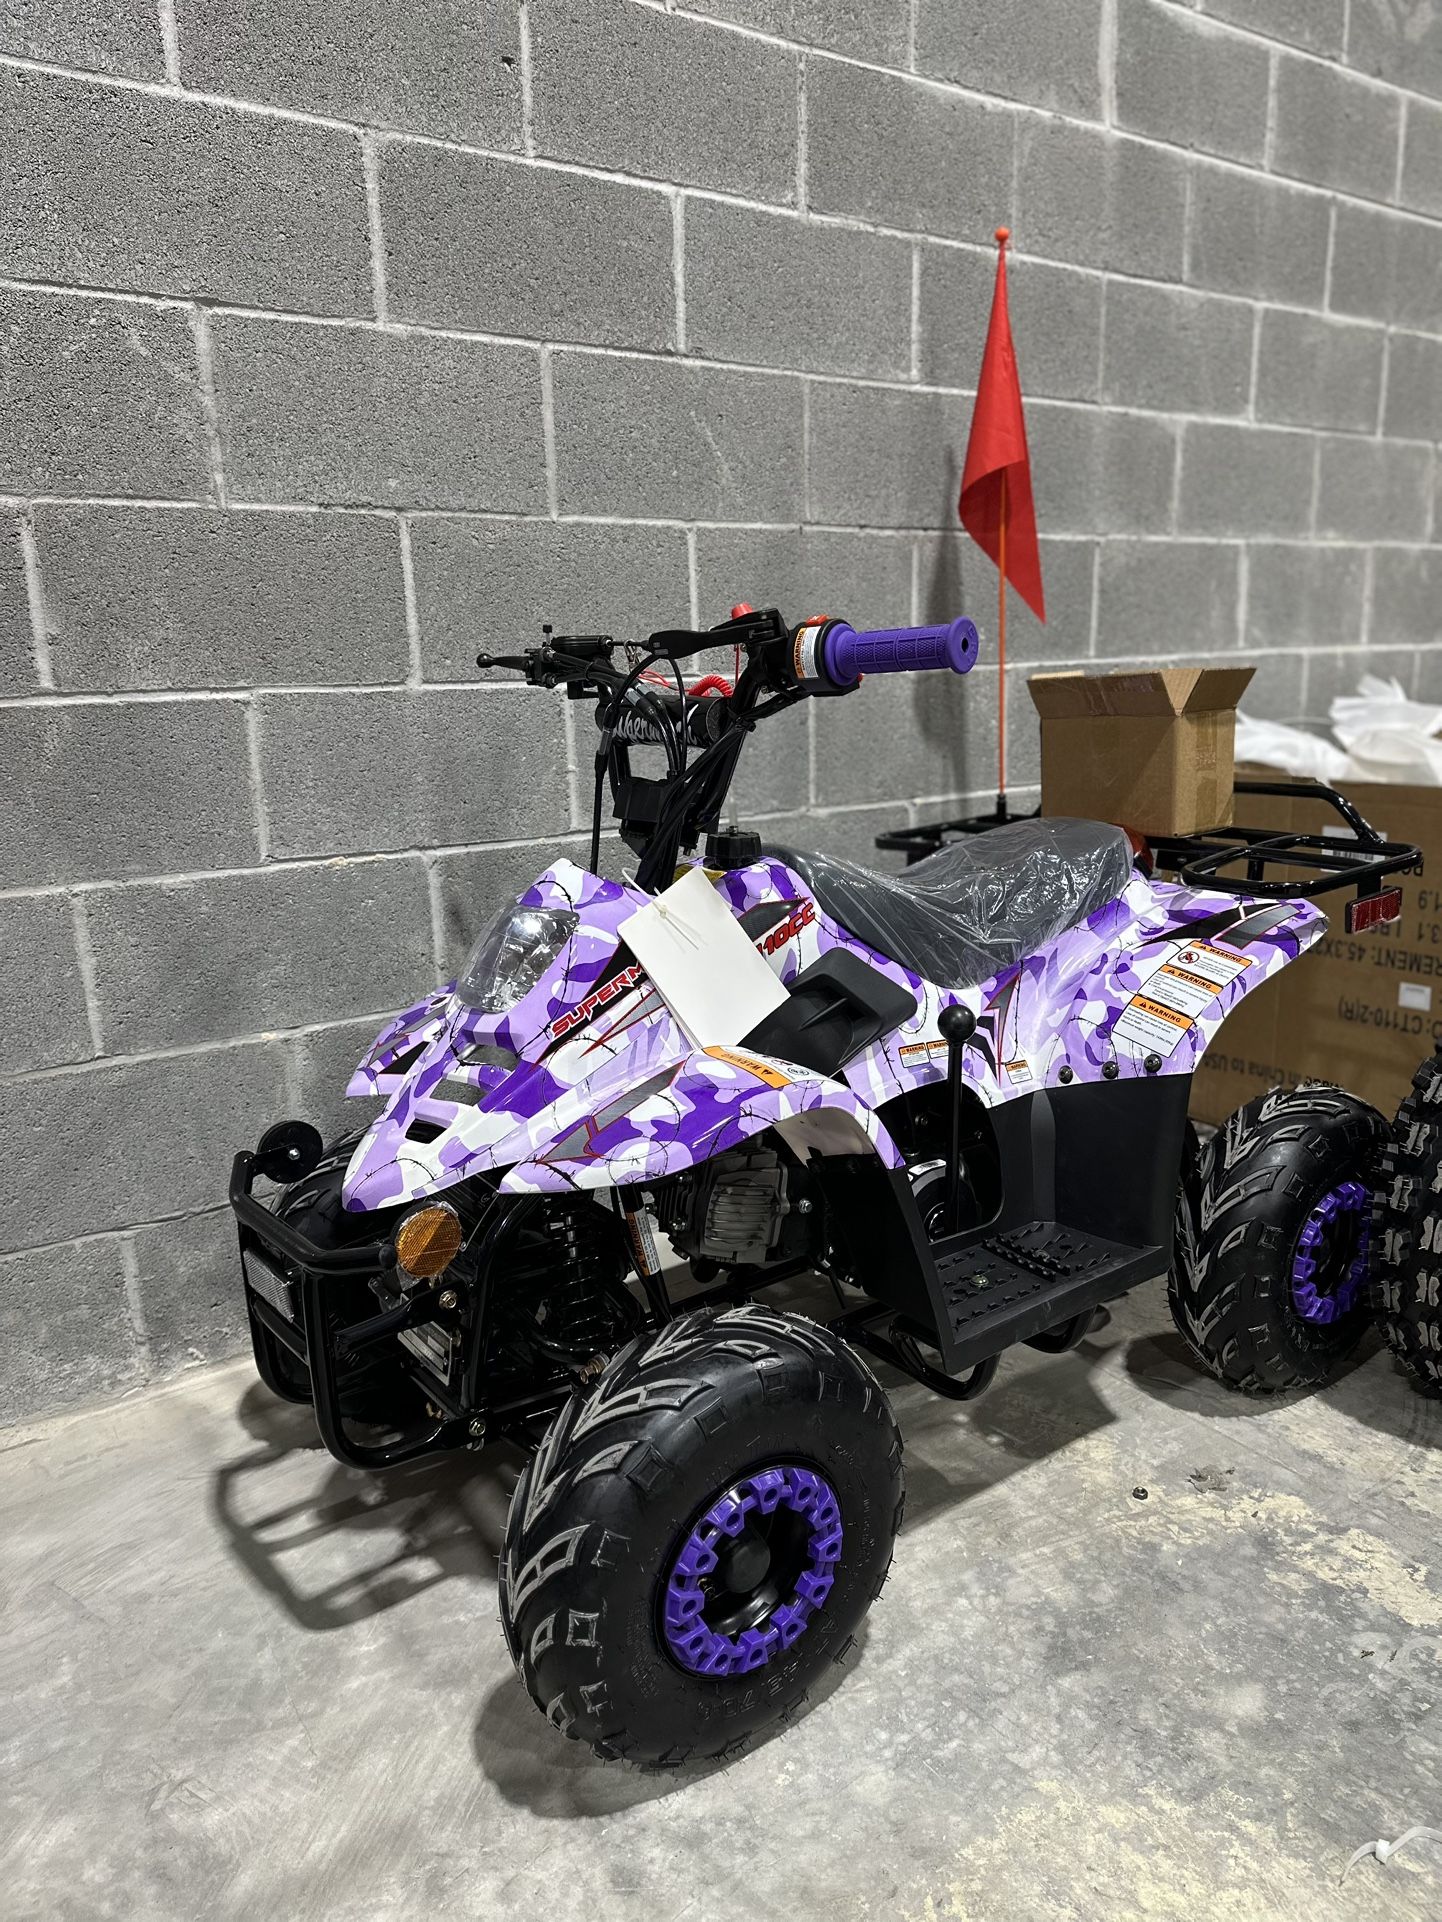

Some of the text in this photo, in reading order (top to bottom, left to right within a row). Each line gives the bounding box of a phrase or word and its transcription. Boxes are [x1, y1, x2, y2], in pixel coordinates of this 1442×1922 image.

[794, 630, 805, 667] WARNING
[1208, 947, 1242, 963] WARNING
[1177, 970, 1211, 990] WARNING
[1148, 1003, 1181, 1023] WARNING
[1338, 995, 1423, 1035] CT110-2(R)
[905, 1045, 924, 1053] WARNING
[720, 1053, 762, 1072] WARNING
